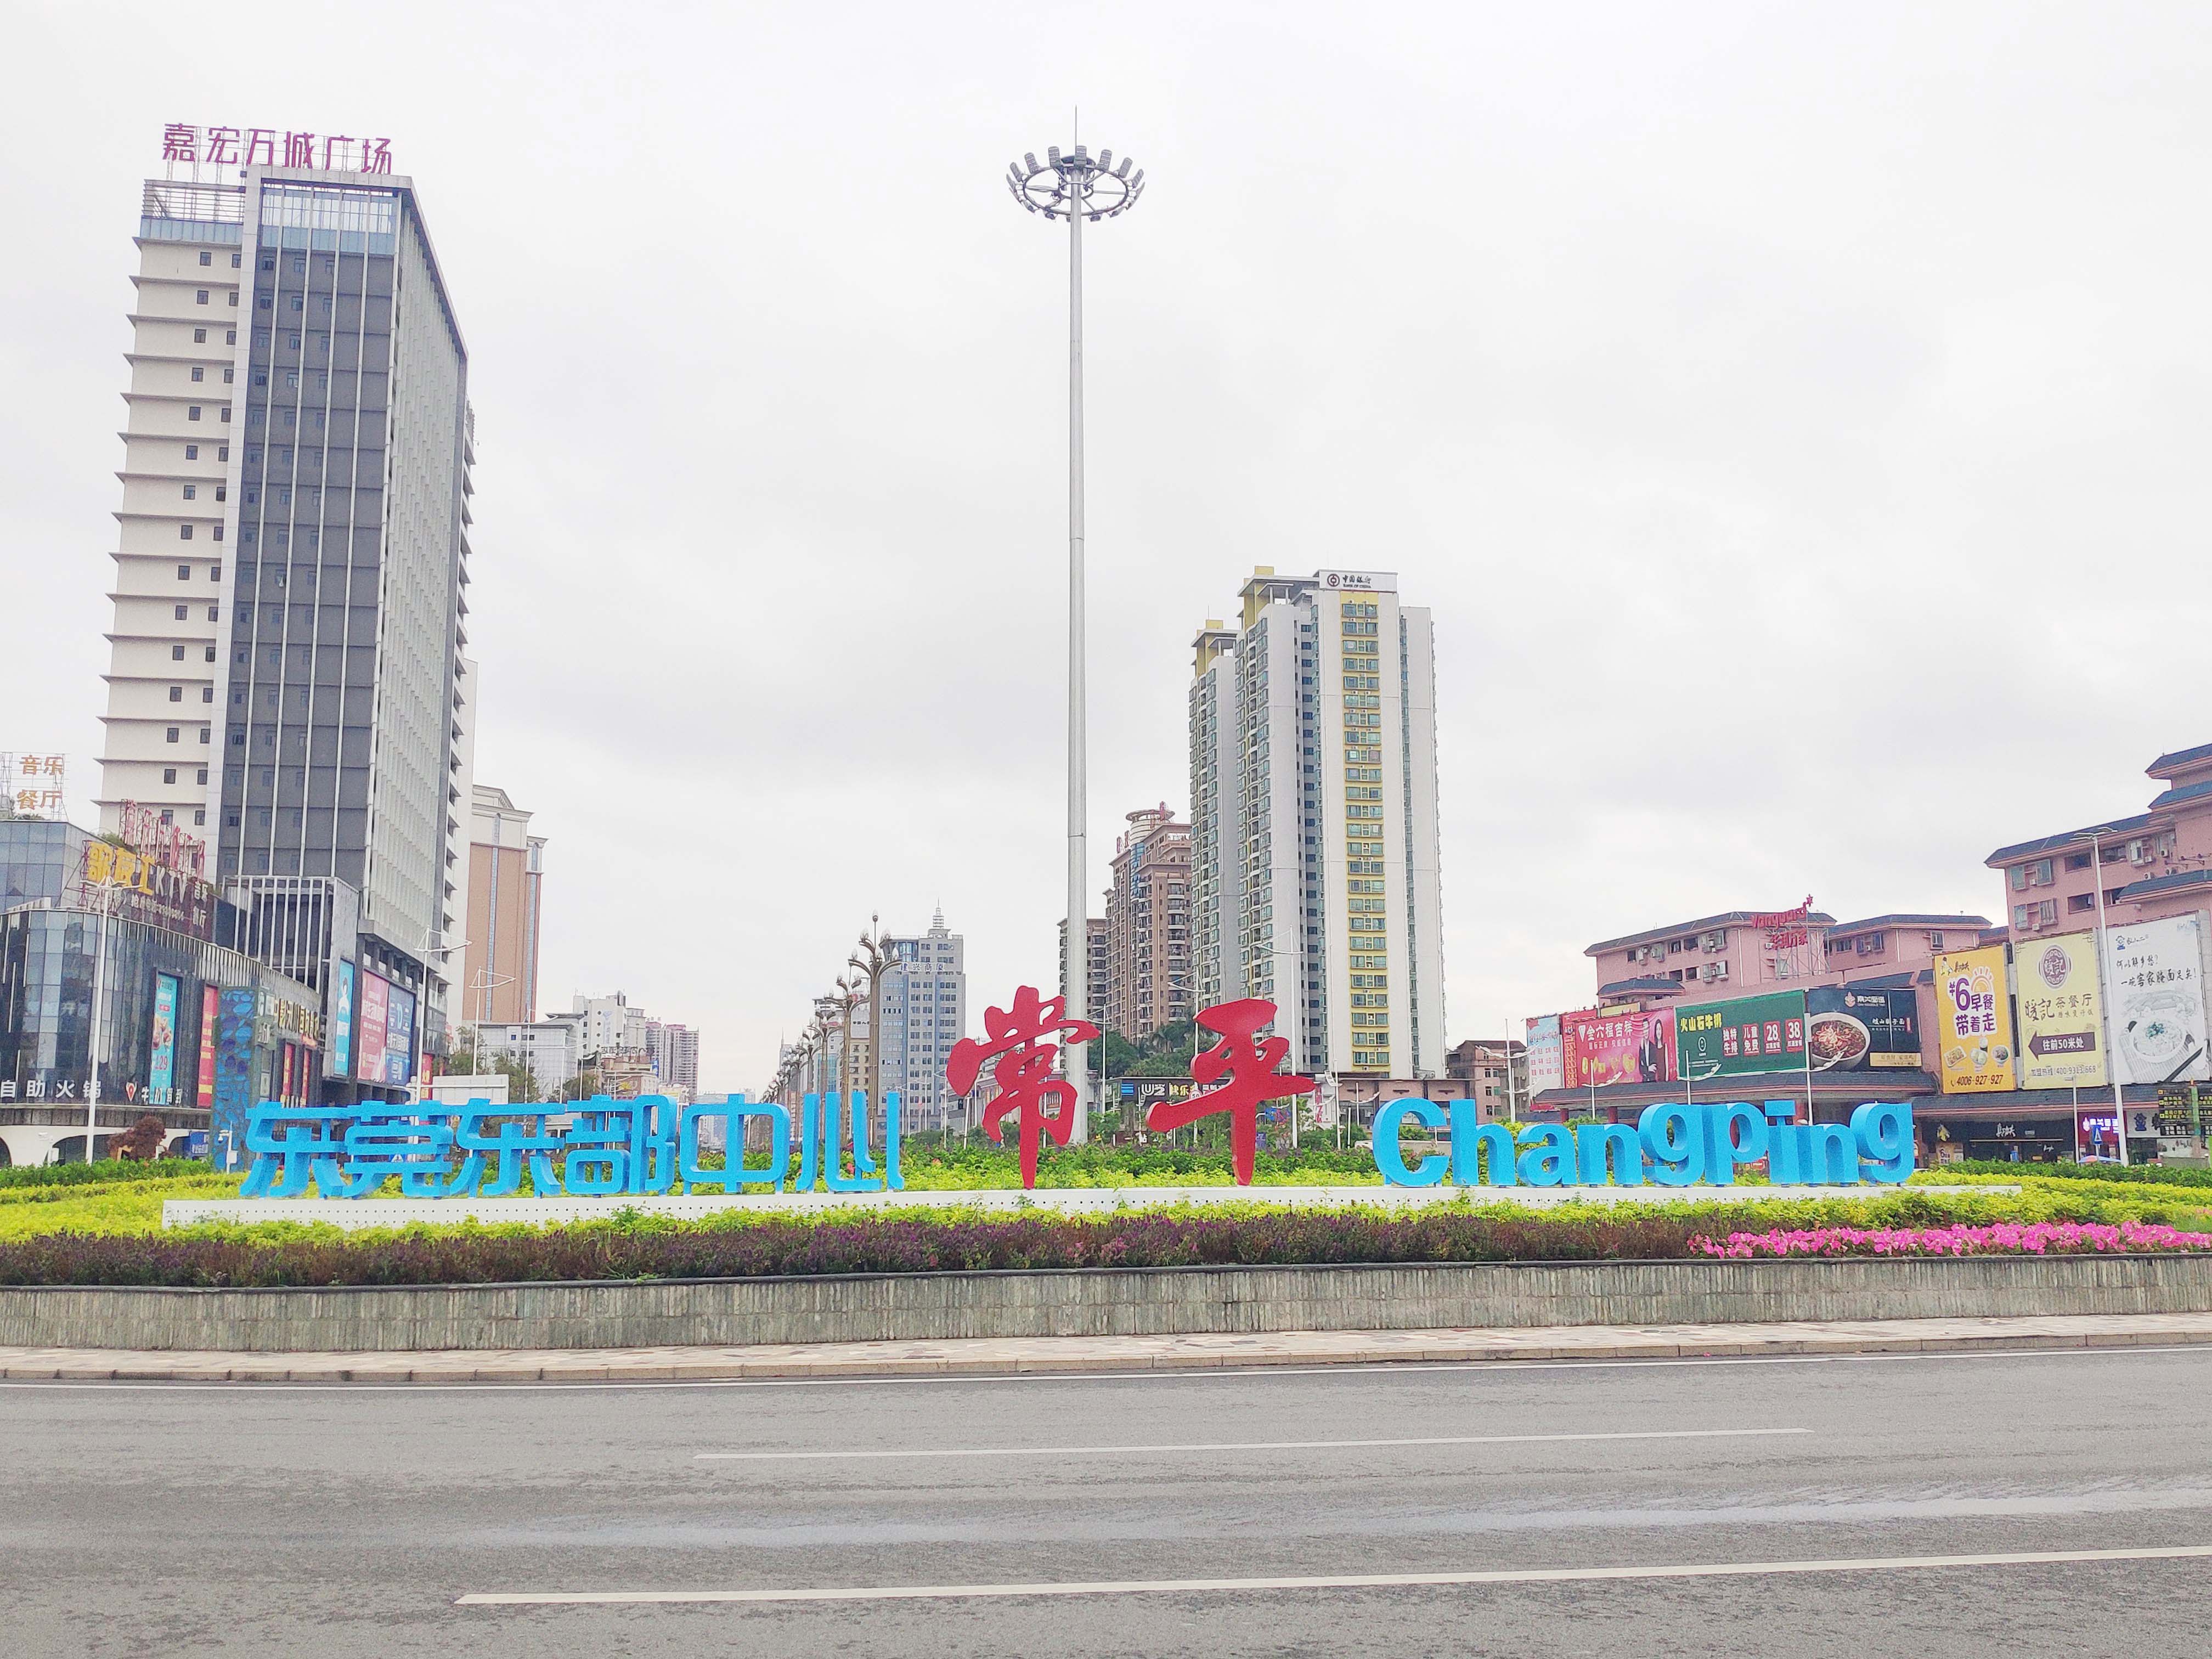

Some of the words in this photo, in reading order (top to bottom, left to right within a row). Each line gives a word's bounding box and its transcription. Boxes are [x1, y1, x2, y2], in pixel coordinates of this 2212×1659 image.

[163, 123, 391, 174] 嘉宏万城广场
[19, 754, 63, 775] 音乐
[17, 789, 63, 810] 餐厅
[1766, 1024, 1779, 1041] 28
[1788, 1022, 1801, 1039] 38
[1956, 1013, 1996, 1036] 带着走
[2042, 1036, 2084, 1051] 往前50米处
[946, 985, 1317, 1189] 常平
[1957, 1075, 2004, 1086] 4006-927-927
[240, 1091, 905, 1198] 东莞东部中心
[1373, 1098, 1914, 1187] Changping
